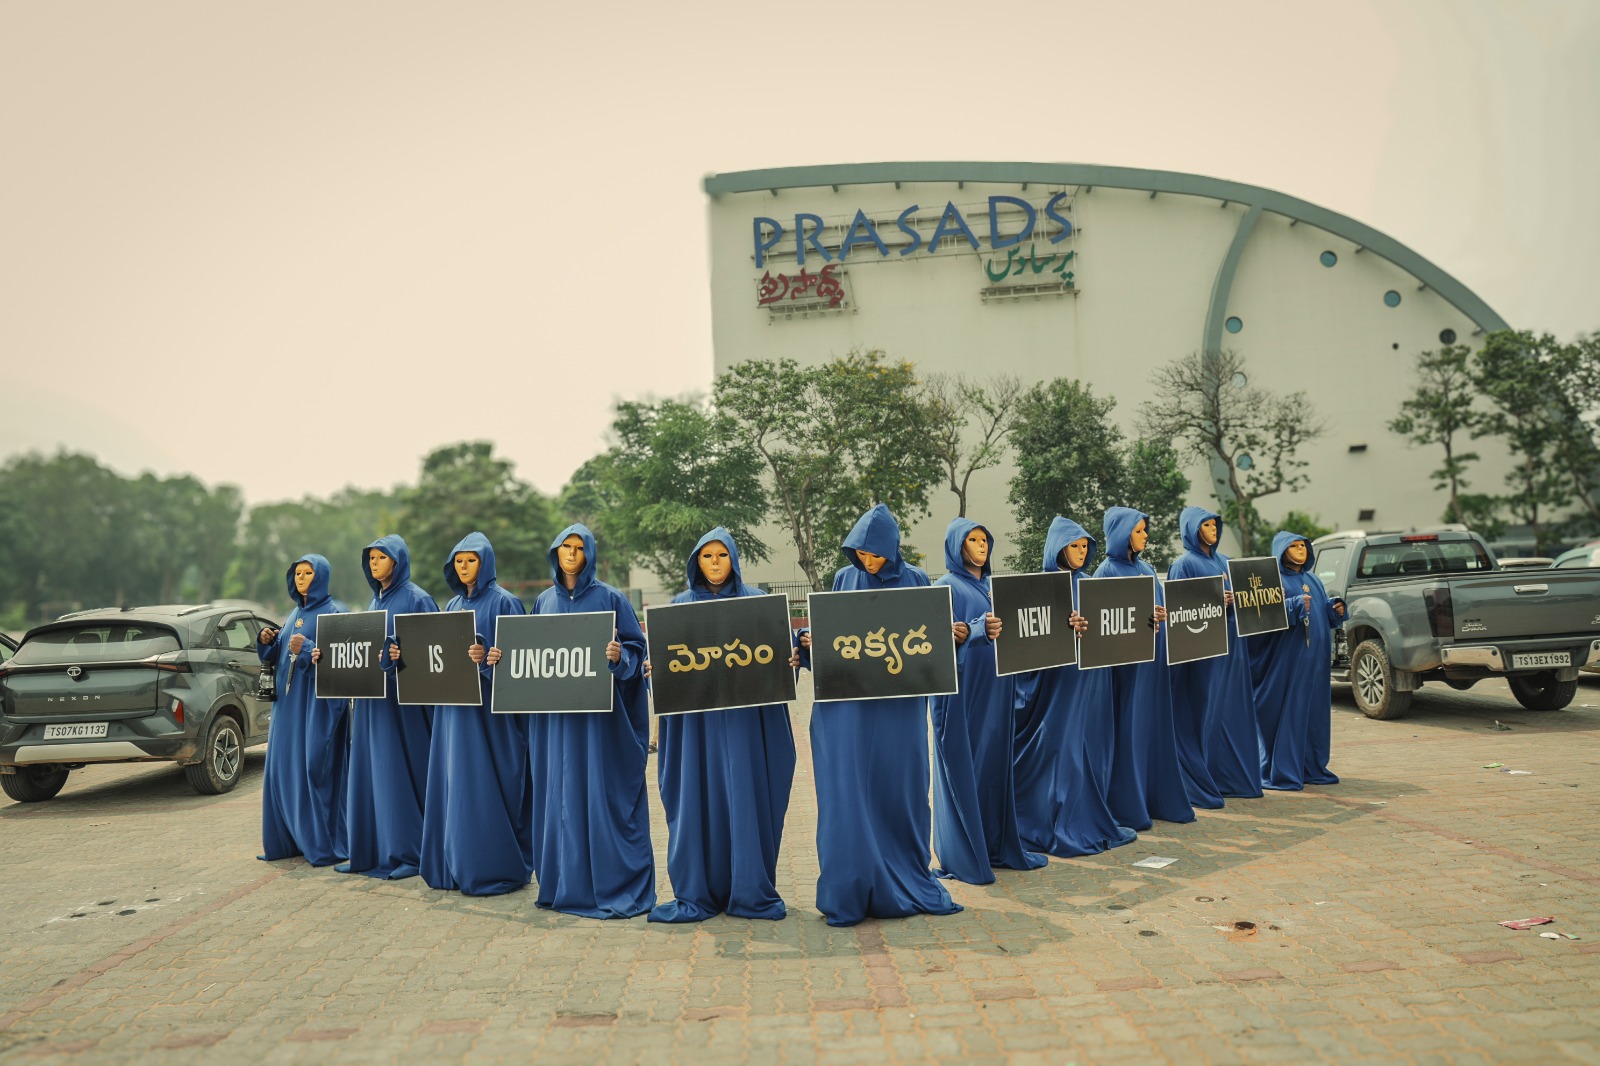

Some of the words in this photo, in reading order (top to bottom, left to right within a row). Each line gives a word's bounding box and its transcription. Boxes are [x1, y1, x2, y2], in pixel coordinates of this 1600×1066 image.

[753, 191, 1073, 269] PRASADS
[1247, 572, 1263, 588] THE
[1169, 606, 1198, 628] prime
[1198, 602, 1223, 621] video
[1235, 587, 1283, 615] TRAITORS
[1017, 605, 1051, 638] NEW
[1100, 606, 1136, 636] RULE
[329, 641, 372, 669] TRUST
[428, 644, 444, 674] IS
[510, 646, 597, 679] UNCOOL
[667, 637, 774, 673] మోసం
[1518, 654, 1570, 666] TS13EX1992
[50, 725, 106, 736] TS07KG1133
